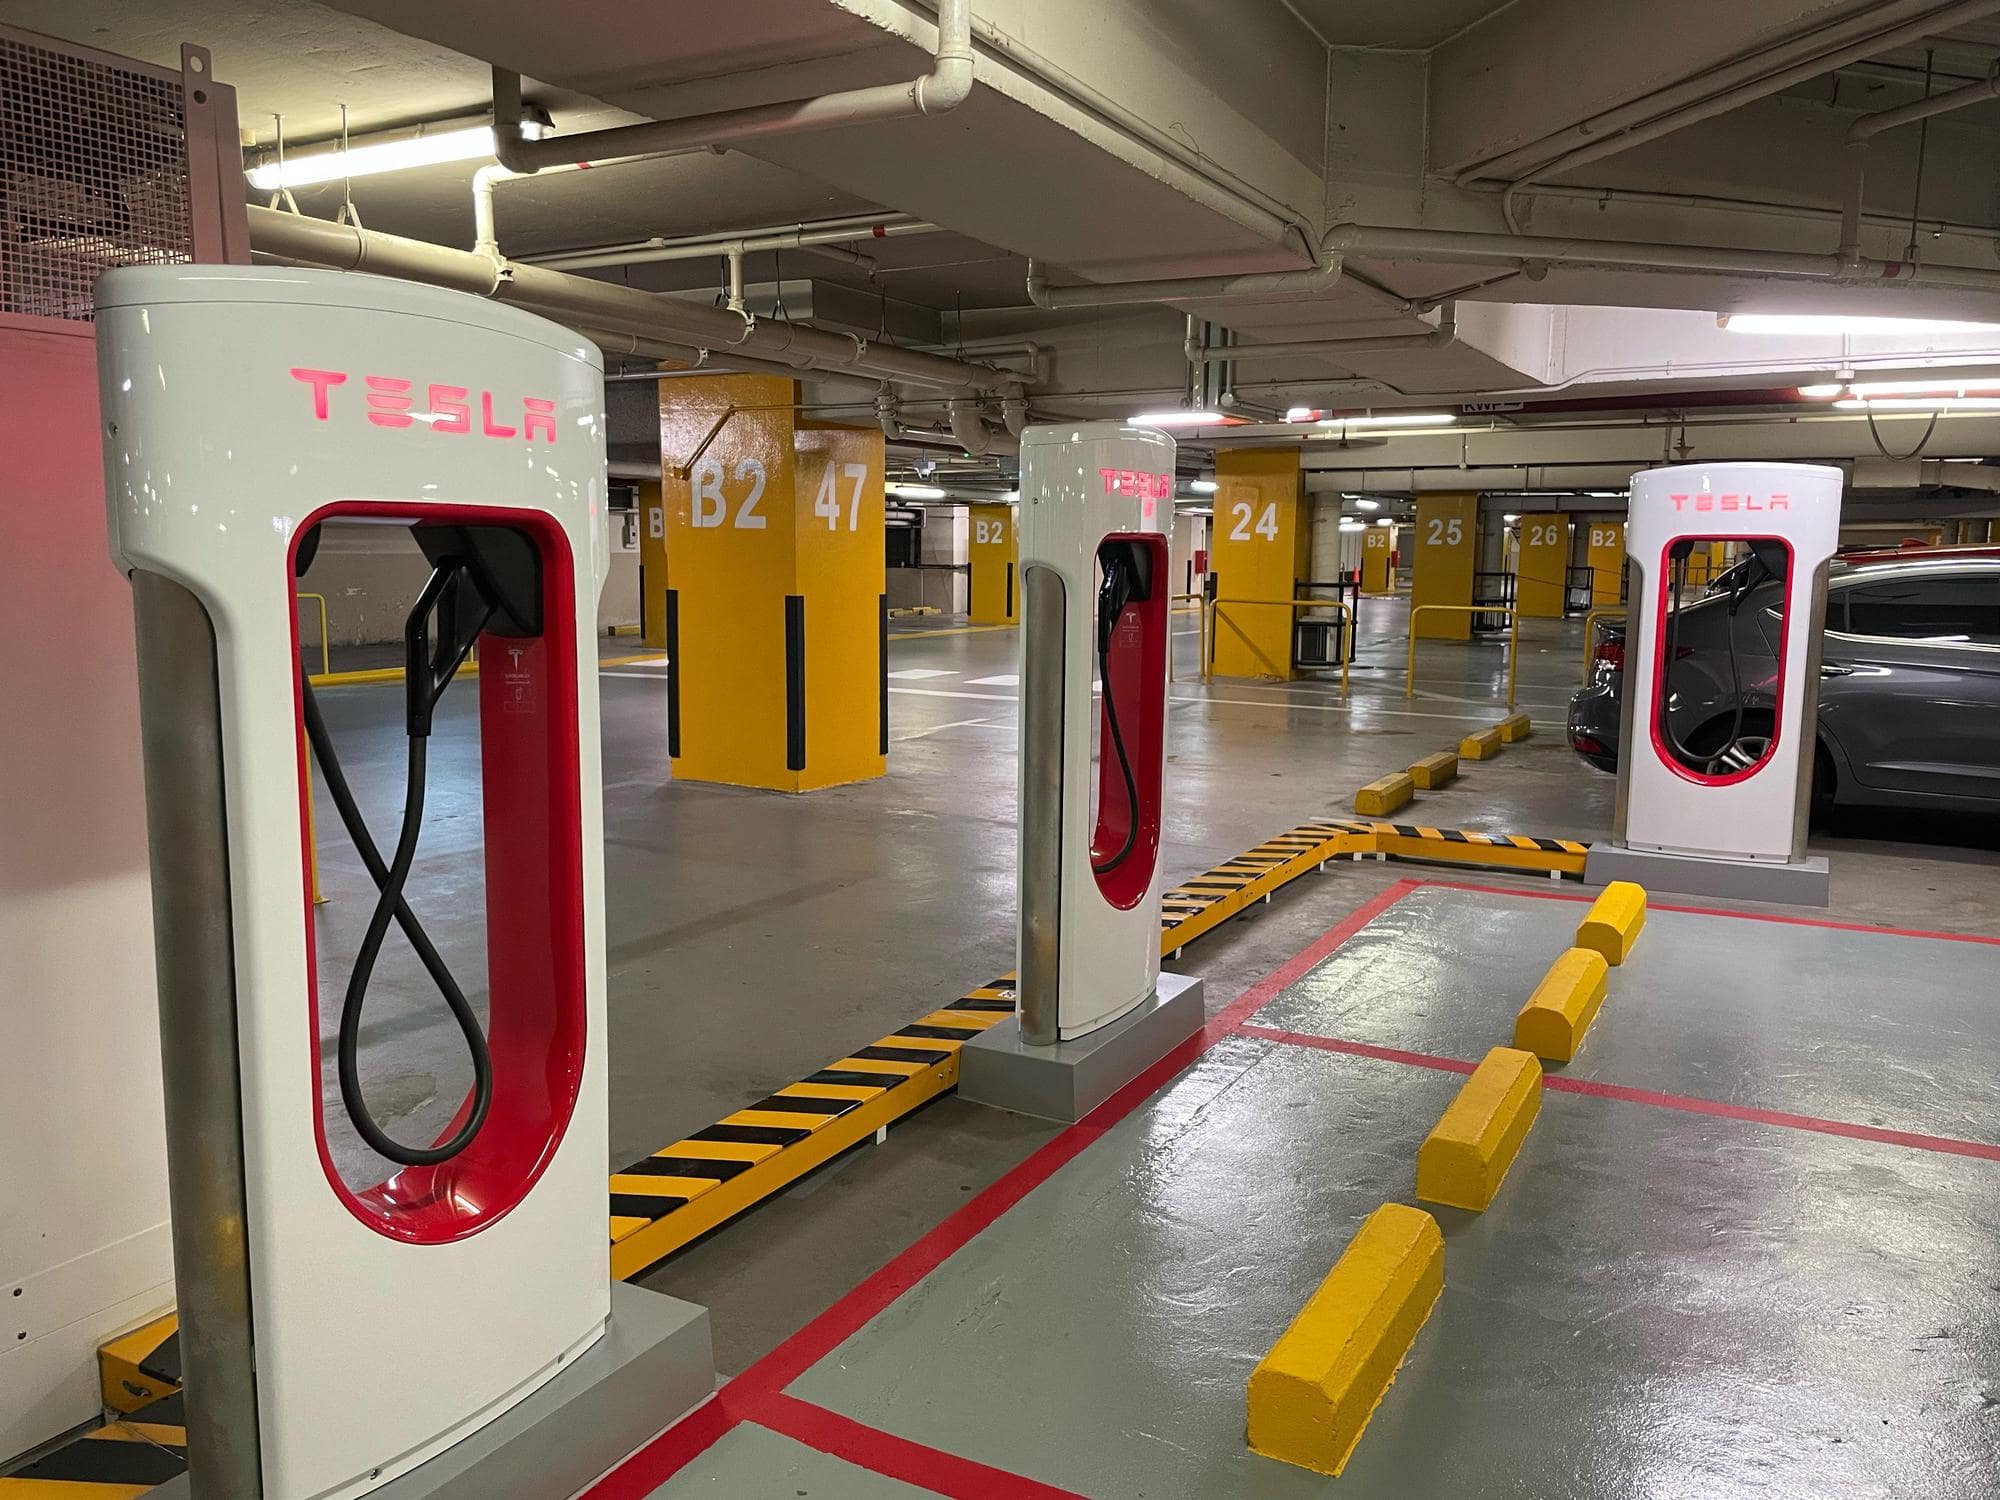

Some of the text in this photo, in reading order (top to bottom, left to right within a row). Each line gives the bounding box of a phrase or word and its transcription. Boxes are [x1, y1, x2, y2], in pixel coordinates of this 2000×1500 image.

[289, 368, 556, 443] TESLA
[691, 457, 767, 529] B2
[814, 461, 867, 531] 47
[1099, 468, 1169, 498] TESLA
[1669, 494, 1789, 511] TESLA
[976, 520, 1003, 544] B2
[1230, 502, 1279, 541] 24
[1426, 519, 1463, 545] 25
[1367, 534, 1385, 547] B2
[1529, 525, 1558, 546] 26
[1591, 530, 1616, 547] B2
